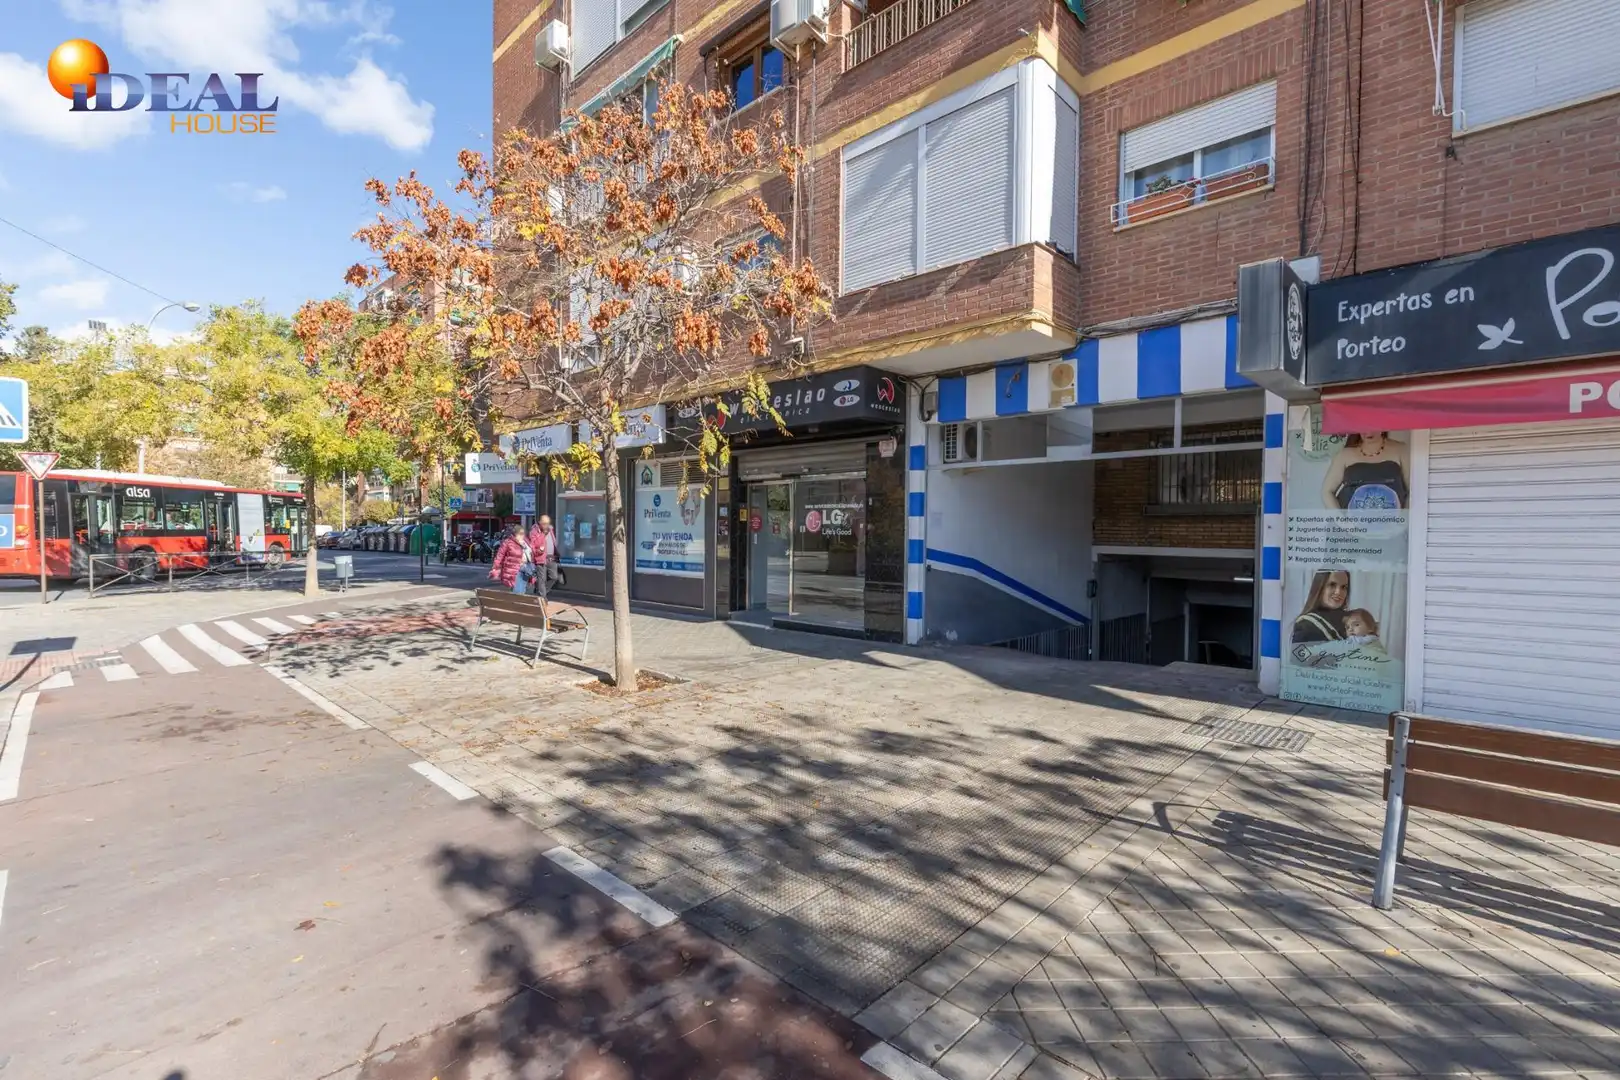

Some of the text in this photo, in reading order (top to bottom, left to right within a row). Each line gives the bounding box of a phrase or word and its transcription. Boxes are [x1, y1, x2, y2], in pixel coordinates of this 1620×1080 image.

[1338, 286, 1475, 325] Expertas en
[1337, 336, 1406, 360] Porteo
[730, 388, 825, 415] weslao
[125, 486, 151, 498] alsa
[644, 508, 671, 518] PriVenta
[822, 509, 842, 525] LG
[652, 532, 660, 540] TU
[822, 528, 852, 536] Life's Good
